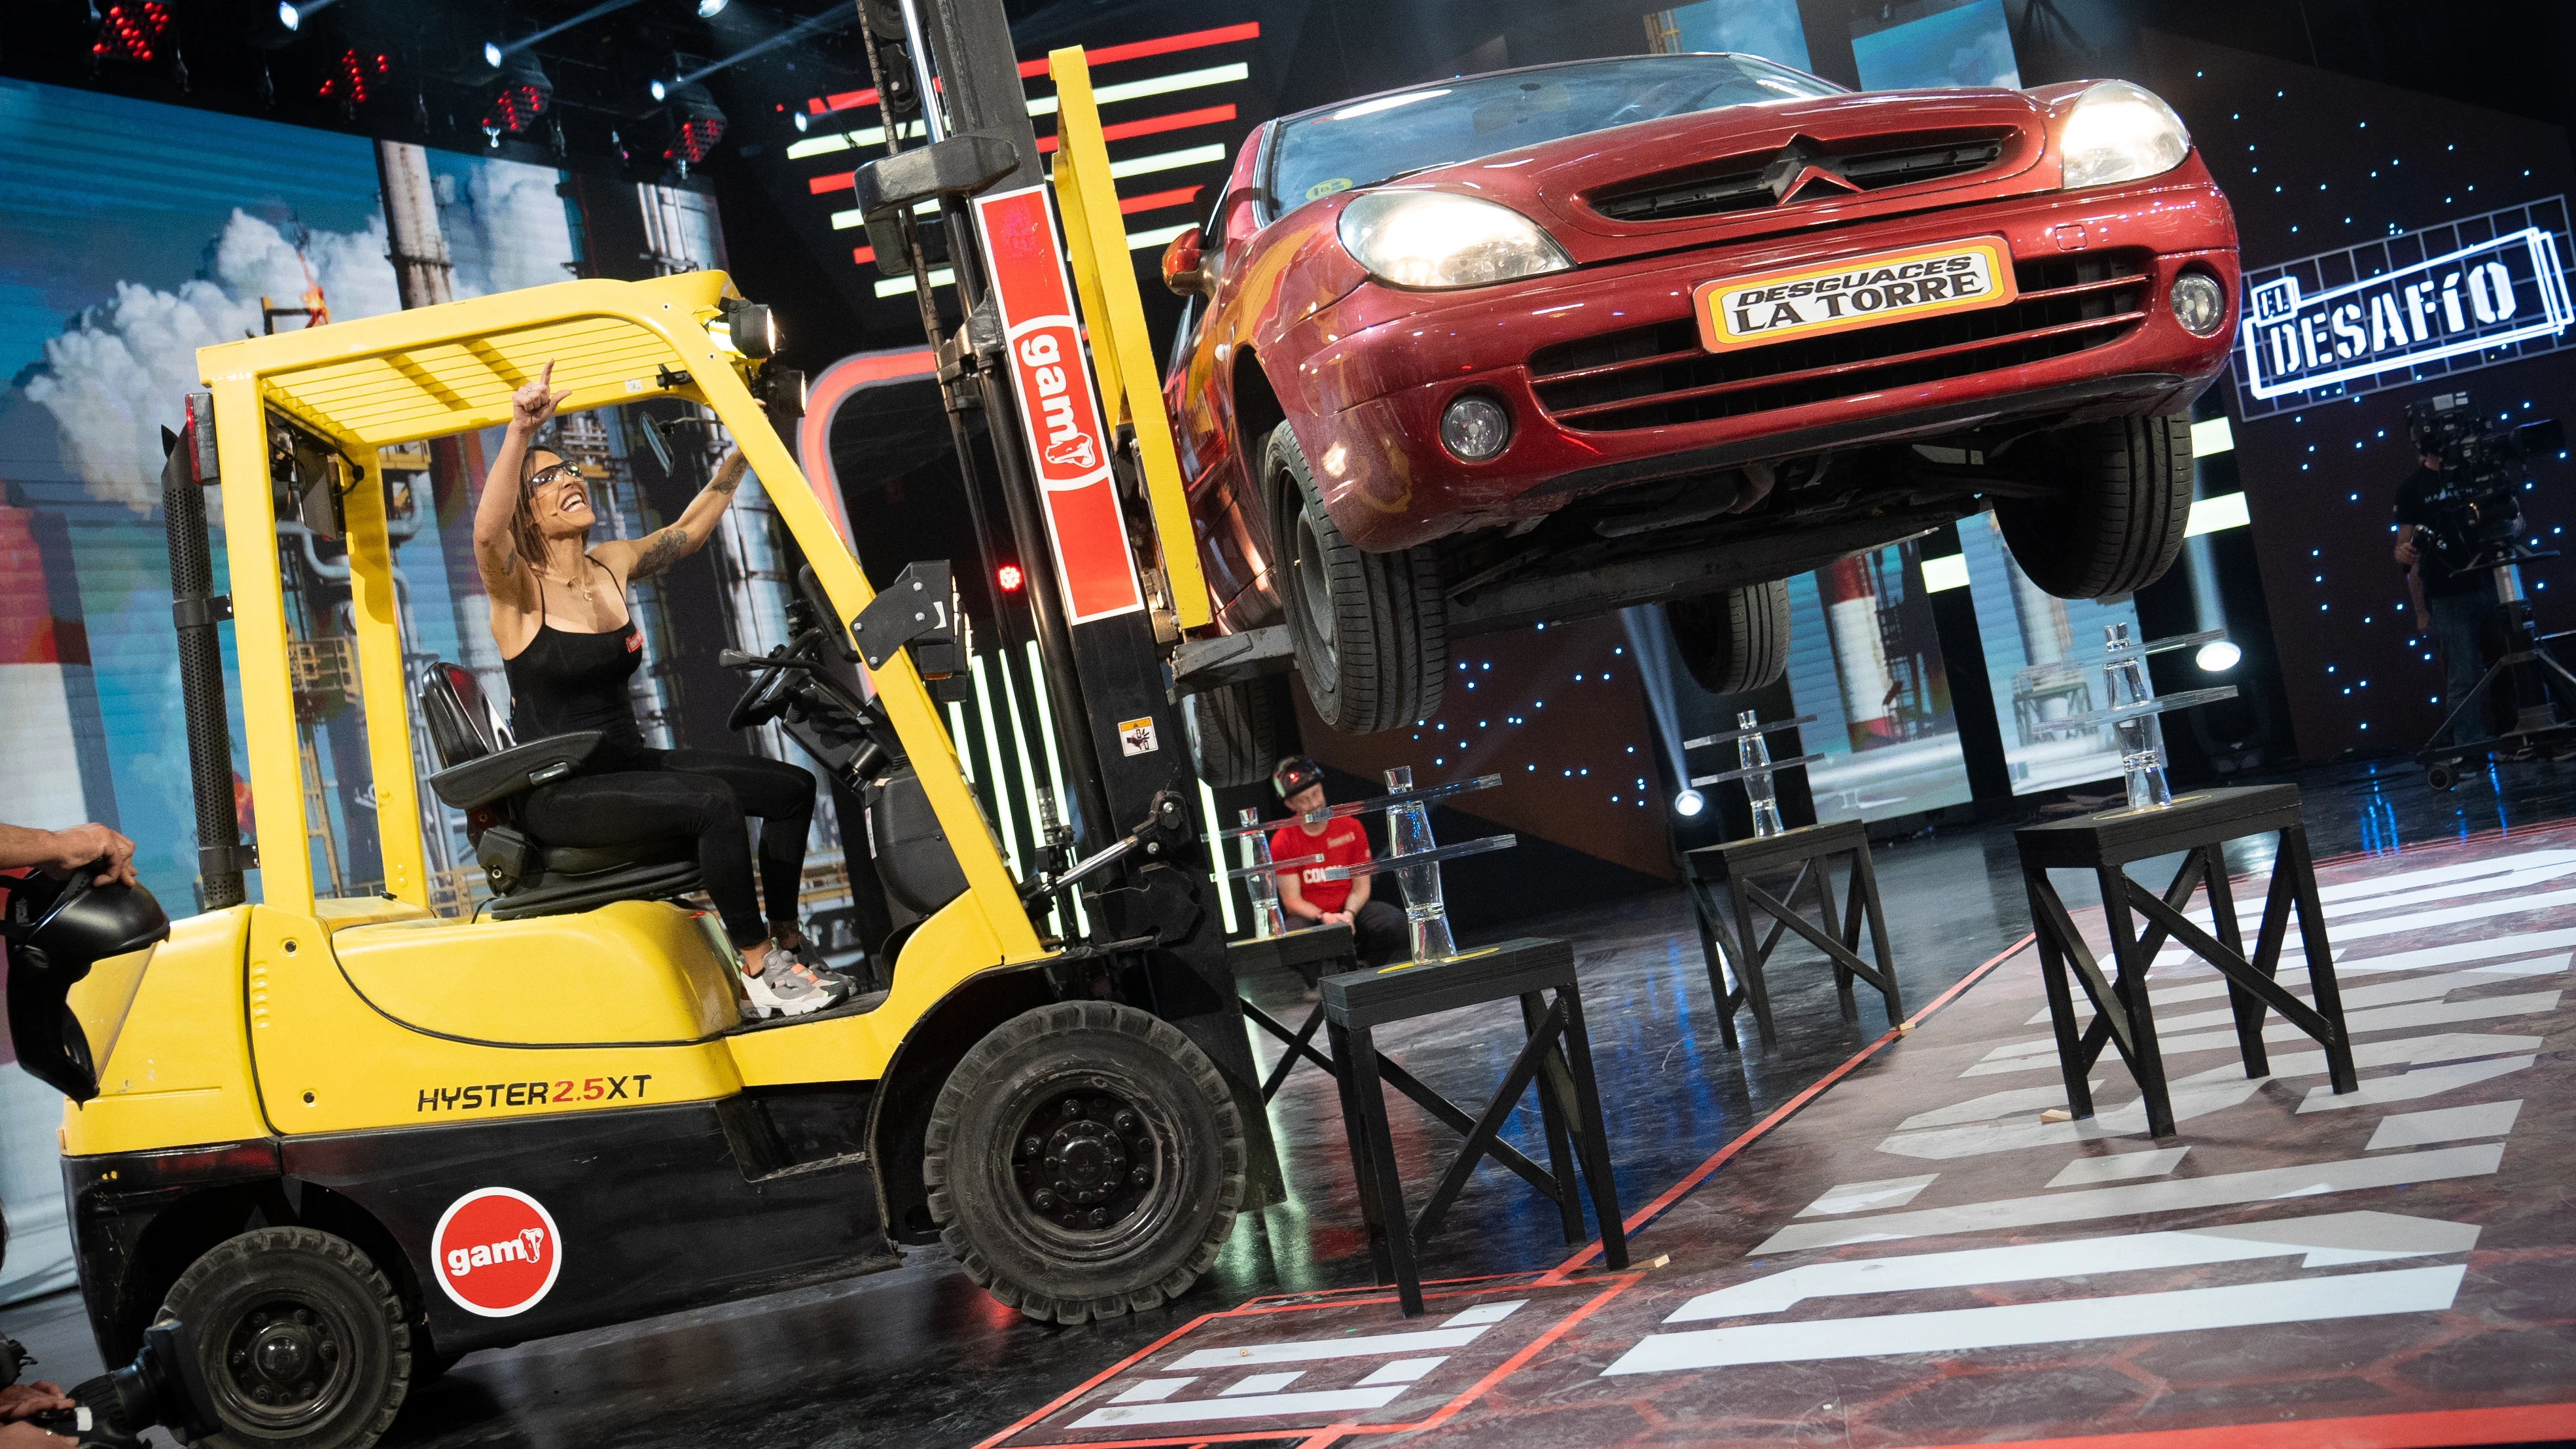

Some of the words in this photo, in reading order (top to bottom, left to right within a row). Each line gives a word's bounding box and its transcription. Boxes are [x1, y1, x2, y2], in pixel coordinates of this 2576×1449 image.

[1732, 303, 1806, 334] LA
[1815, 272, 1984, 317] TORRE
[1737, 257, 1971, 308] DESGUACES
[2261, 287, 2290, 317] EL
[1020, 333, 1079, 446] gam
[448, 1237, 528, 1276] gam
